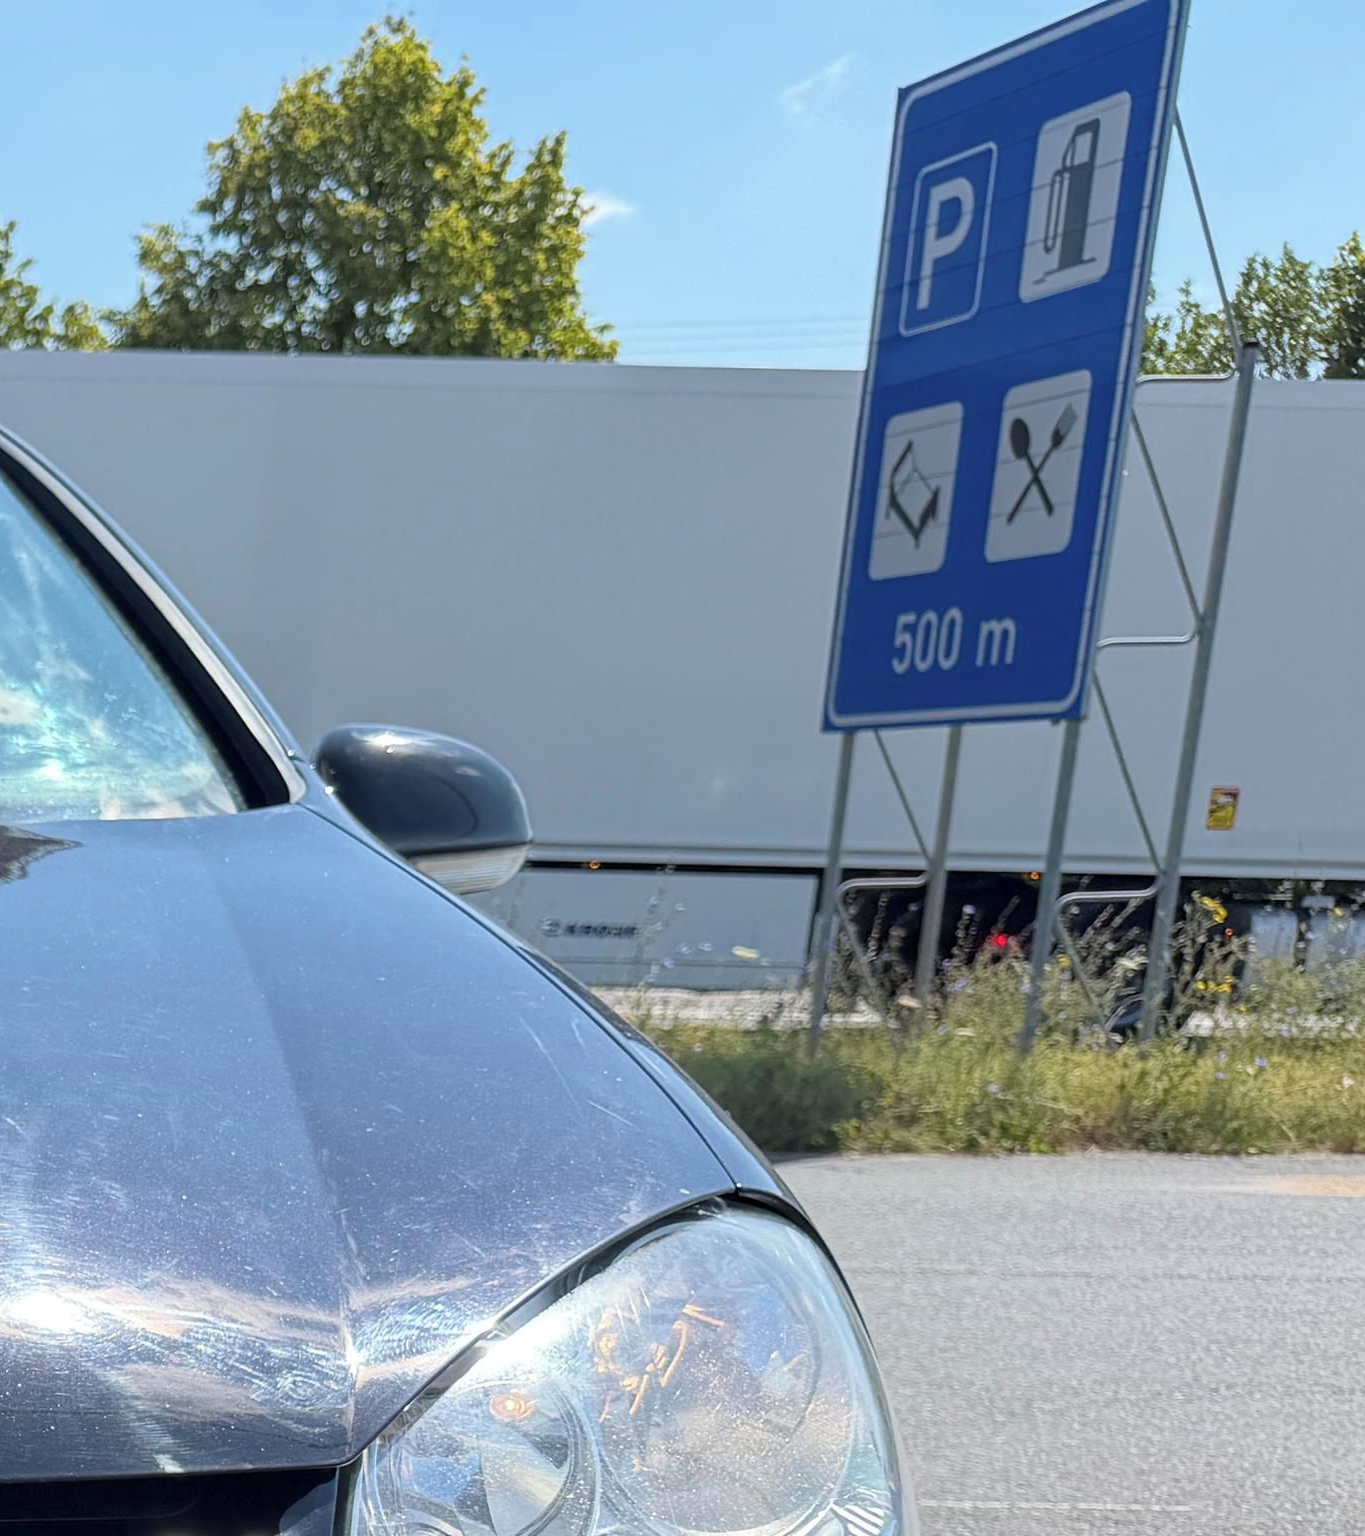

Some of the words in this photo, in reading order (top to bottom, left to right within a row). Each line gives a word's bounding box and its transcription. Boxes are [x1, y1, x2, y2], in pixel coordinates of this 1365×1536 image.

[916, 176, 975, 311] P
[891, 606, 963, 675] 500
[975, 615, 1017, 668] m
